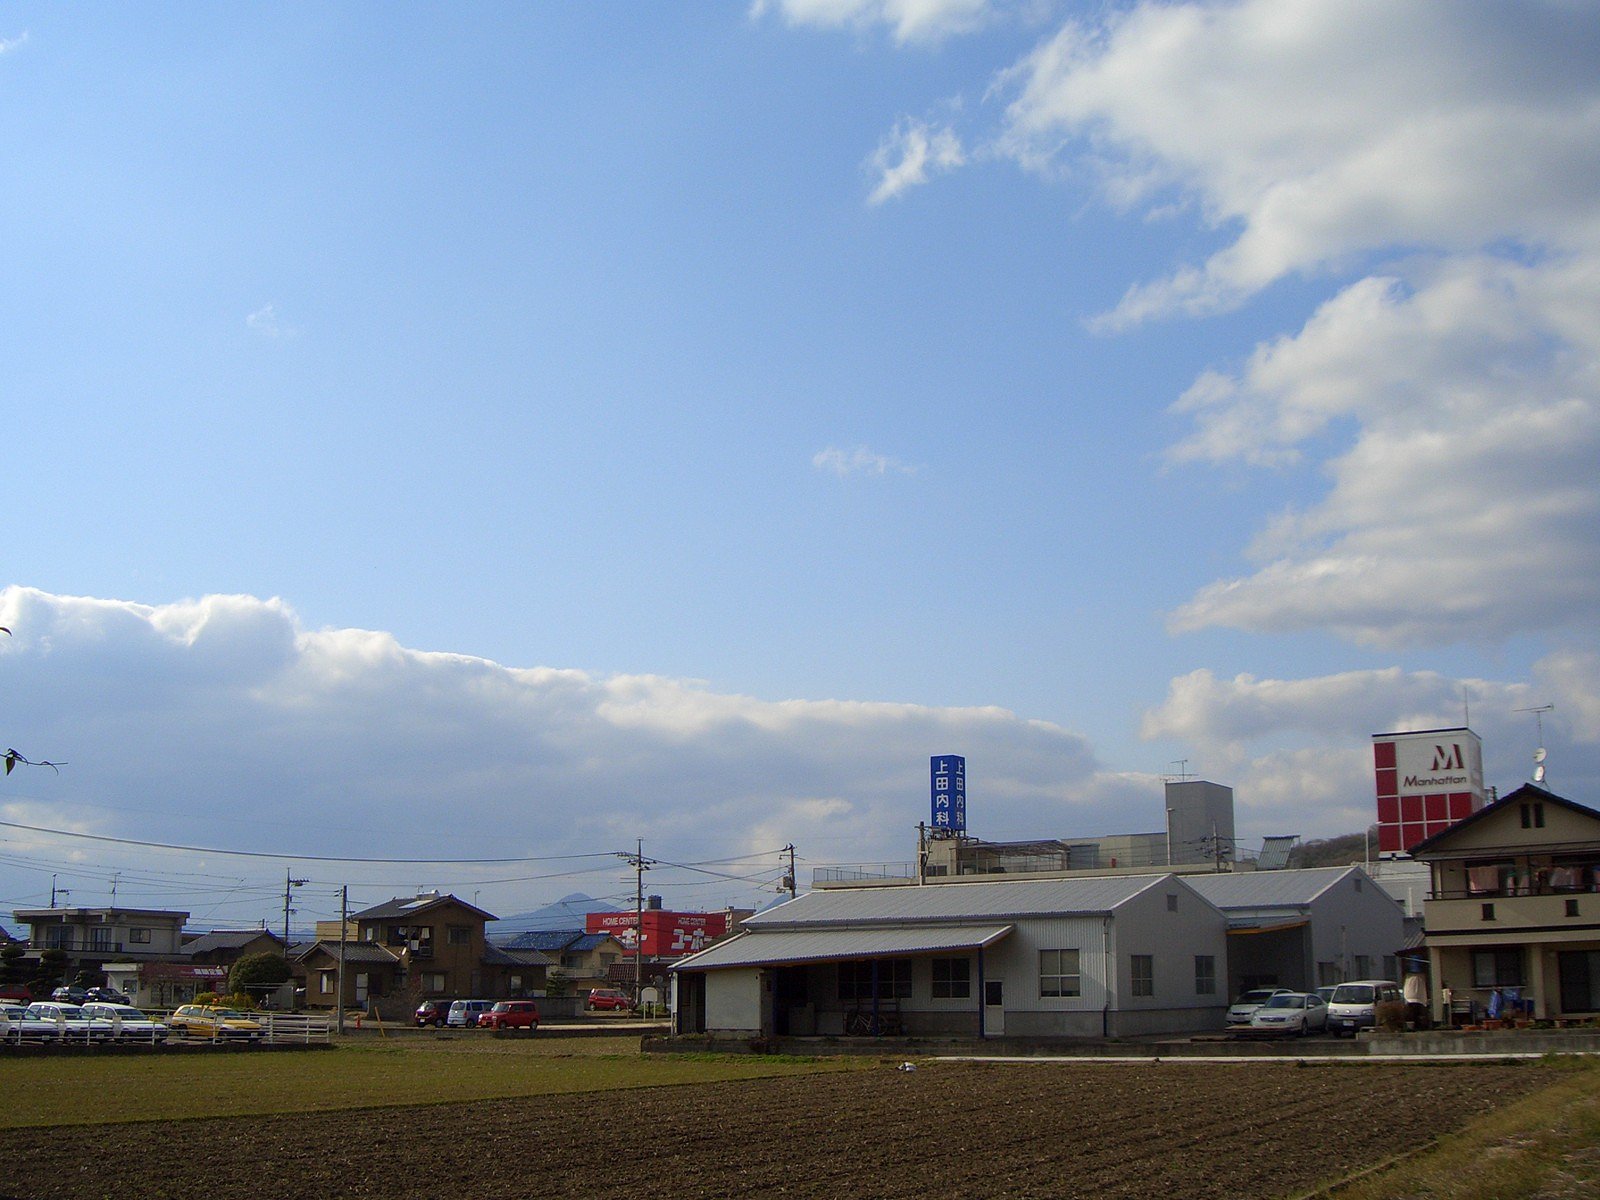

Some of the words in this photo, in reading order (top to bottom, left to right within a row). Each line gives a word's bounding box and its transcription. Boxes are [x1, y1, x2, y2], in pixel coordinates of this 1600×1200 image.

[1430, 744, 1465, 770] M
[1403, 775, 1467, 788] Manhattan
[935, 760, 950, 825] 上田内科
[956, 760, 964, 826] 上田内科
[602, 917, 618, 925] HOME
[678, 917, 689, 925] HOME
[690, 918, 706, 926] CENTER
